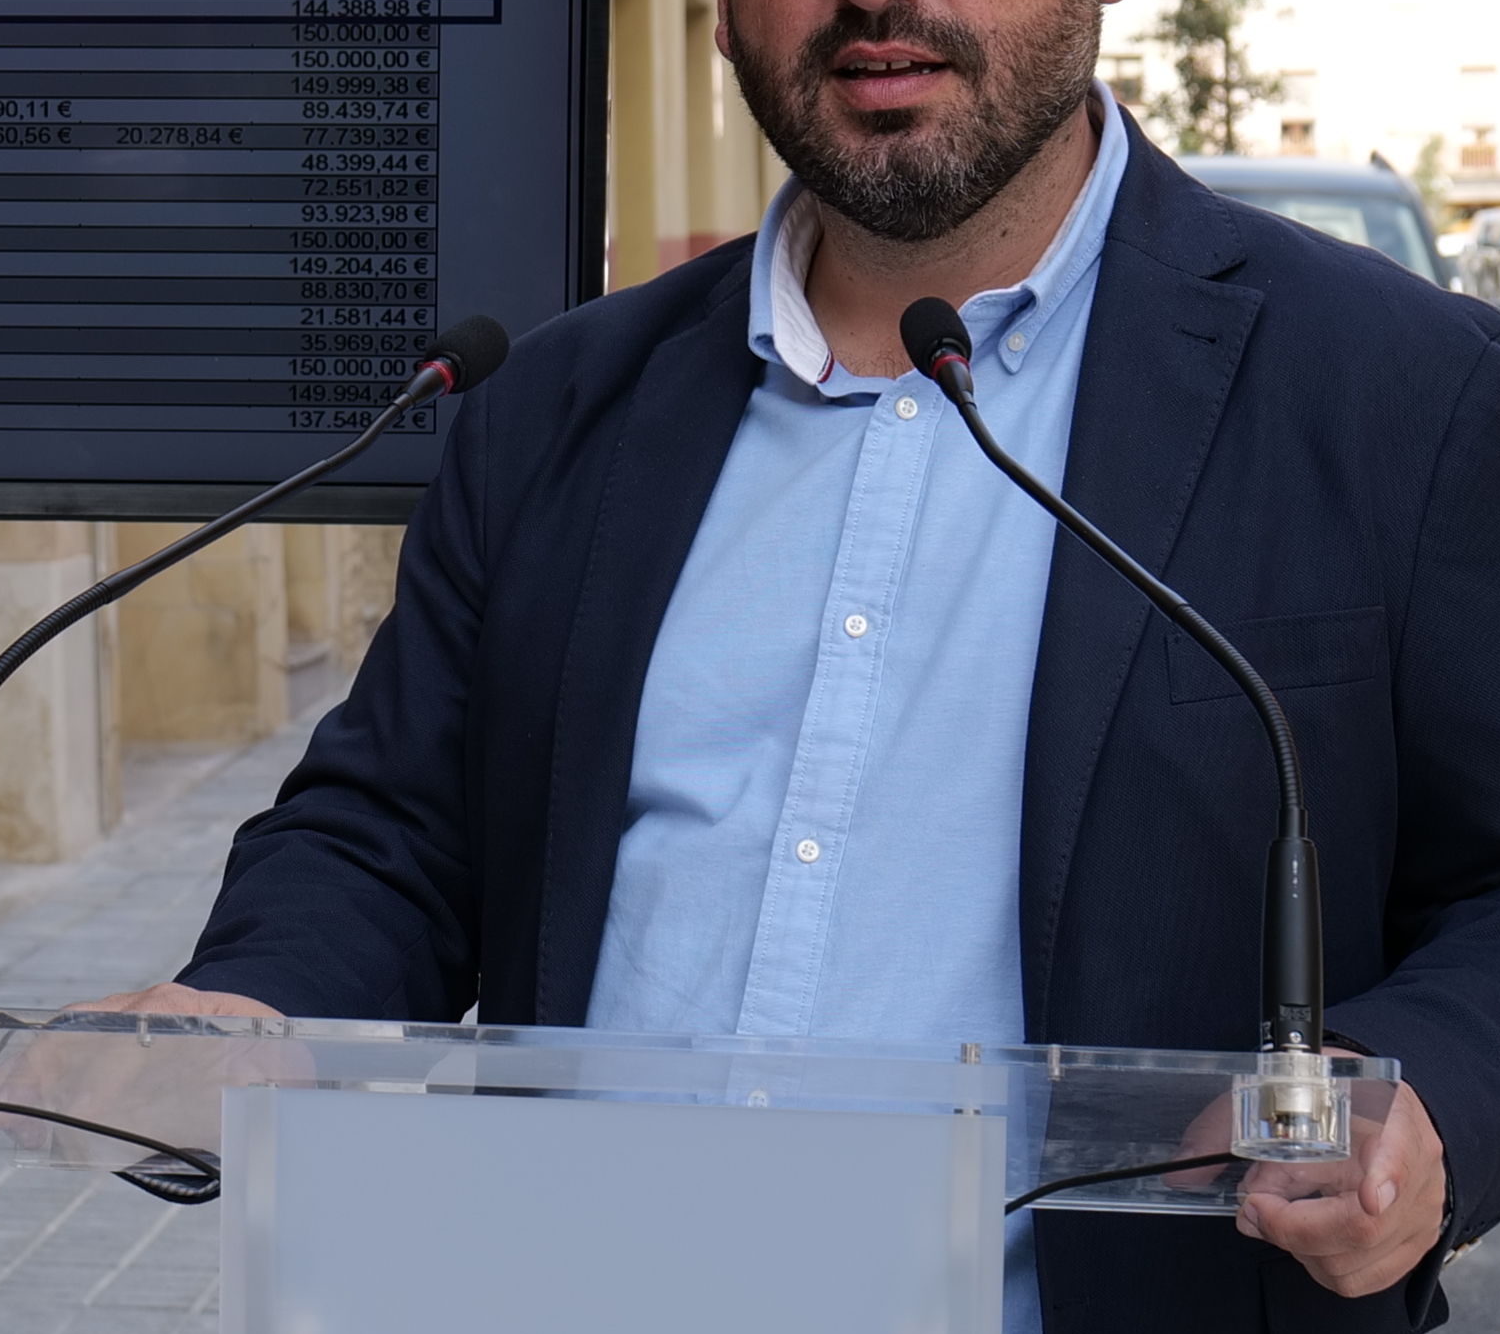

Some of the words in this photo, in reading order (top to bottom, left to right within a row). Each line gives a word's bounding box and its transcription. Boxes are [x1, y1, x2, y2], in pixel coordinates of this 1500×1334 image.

[291, 50, 410, 71] 150.000,00
[415, 50, 431, 68] €
[56, 125, 72, 143] €
[116, 127, 223, 148] 20.278,84
[227, 127, 244, 145] €
[302, 127, 409, 148] 77.739,32
[414, 127, 431, 145] €
[287, 257, 406, 278] 149.204,46
[413, 257, 429, 275] €
[412, 411, 428, 430] €
